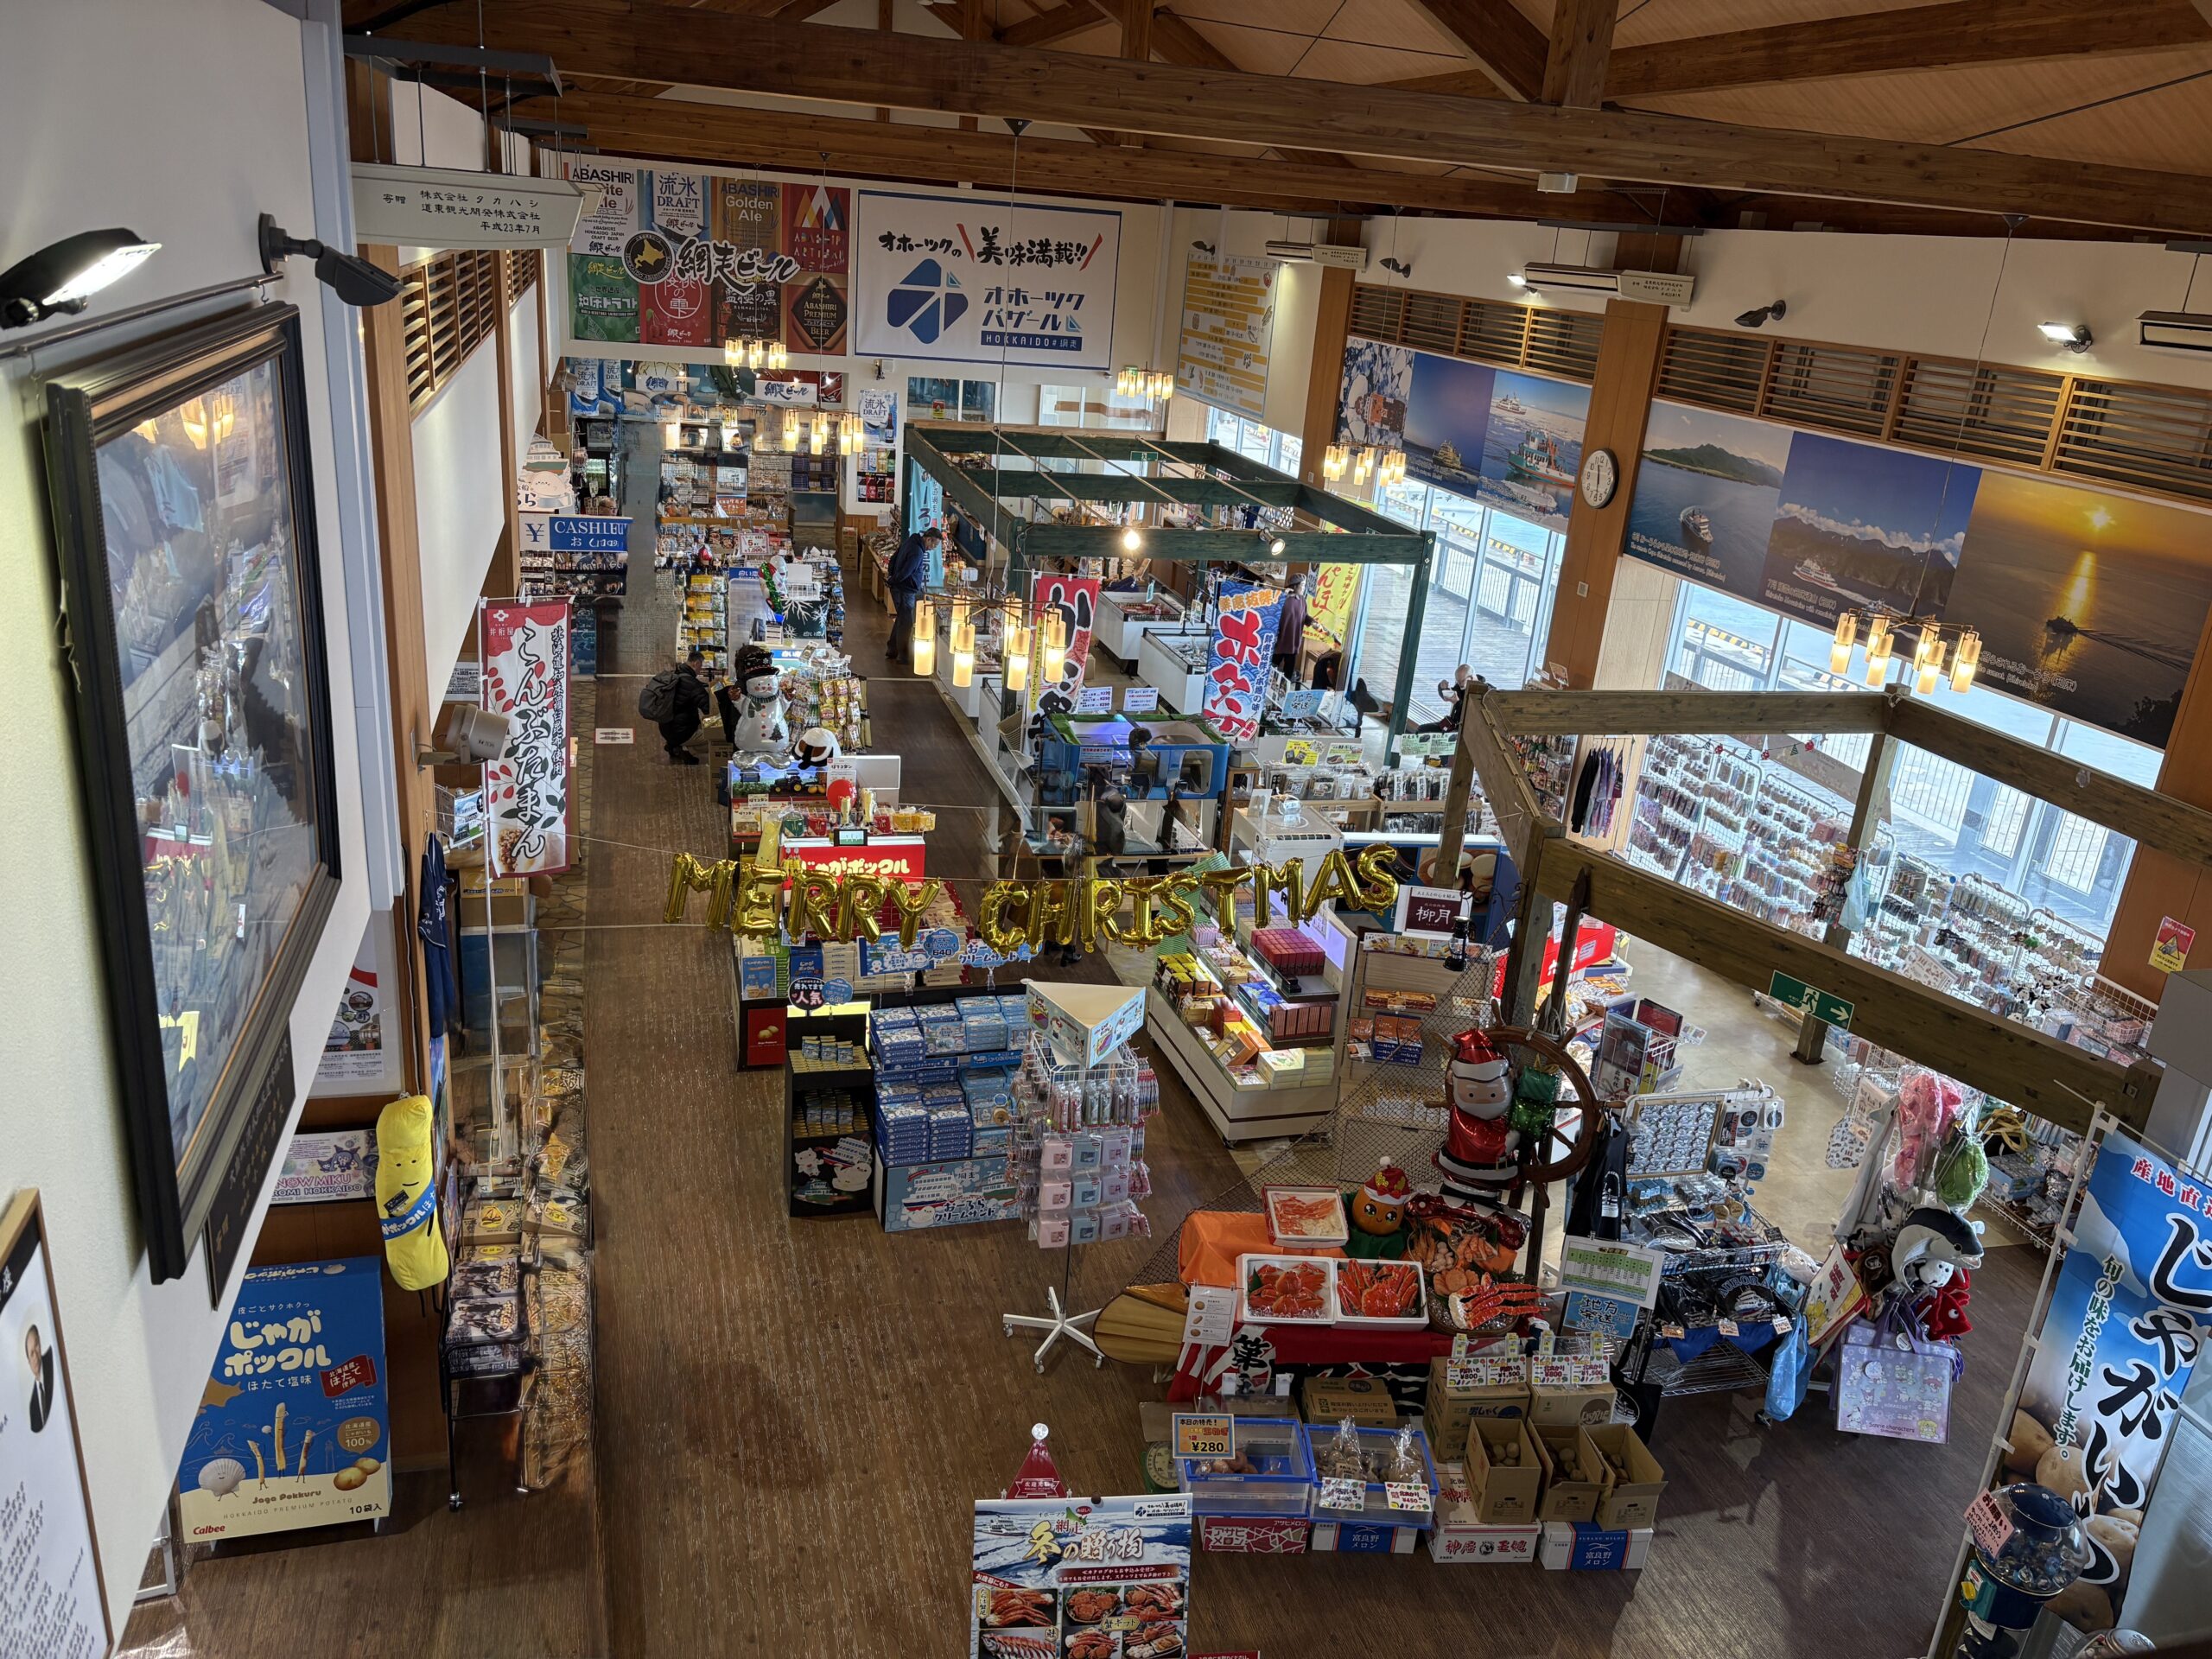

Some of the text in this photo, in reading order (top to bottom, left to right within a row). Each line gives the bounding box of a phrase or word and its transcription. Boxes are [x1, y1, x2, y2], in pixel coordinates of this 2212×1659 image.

[573, 168, 634, 184] ABASHIRI
[659, 175, 698, 197] 流氷
[721, 183, 779, 199] ABASHIRI
[383, 194, 406, 205] 寄贈
[420, 190, 468, 202] 株式会社
[658, 196, 700, 208] DRAFT
[726, 196, 773, 211] Golden
[738, 209, 763, 222] Ale
[480, 221, 540, 234] 平成23年7月
[878, 231, 963, 258] オホーツクの
[674, 235, 801, 293] 網走ビール
[804, 302, 837, 310] ABASHIRI
[984, 286, 1085, 311] オホーツク
[804, 309, 836, 319] PREMIUM
[982, 309, 1063, 331] バザール
[811, 327, 830, 336] BEER
[985, 334, 1051, 347] HOKKAIDO
[864, 397, 887, 410] 流氷
[512, 626, 550, 859] こんぶたまん
[663, 851, 941, 953] MERRY
[978, 841, 1400, 957] CHRISTMAS
[1415, 906, 1452, 925] 柳月
[795, 990, 823, 1006] 人気
[276, 1173, 352, 1188] NOW MIKU
[273, 1184, 362, 1198] ROMI HOKKAIDO
[944, 1198, 986, 1212] おーろら
[934, 1207, 996, 1222] クリームサンド
[1719, 1275, 1772, 1299] AURORA
[238, 1301, 311, 1315] 皮ごとサクホクっ
[1581, 1298, 1619, 1315] 地方
[230, 1309, 321, 1350] じゃが
[224, 1344, 332, 1377] ポックル
[2051, 1255, 2126, 1461] 旬の味をお届けします。
[247, 1375, 313, 1392] ほたて塩味
[329, 1366, 361, 1388] ほたて
[1179, 1418, 1217, 1427] 本日の特売!
[346, 1437, 372, 1447] 100%
[1192, 1441, 1225, 1453] ¥280
[252, 1489, 321, 1505] Jaga Pokkuru
[223, 1497, 353, 1520] HOKKAIDO PREMIUM POTATO
[349, 1503, 382, 1515] 10袋入
[1981, 1492, 2008, 1532] お願い
[193, 1523, 226, 1535] Calbee
[1055, 1520, 1084, 1535] 網走
[1214, 1527, 1246, 1537] アサヒ
[1022, 1520, 1144, 1565] 冬の贈り物
[1212, 1536, 1245, 1546] メロン
[1352, 1534, 1380, 1542] 富良野
[1585, 1551, 1612, 1560] 富良野
